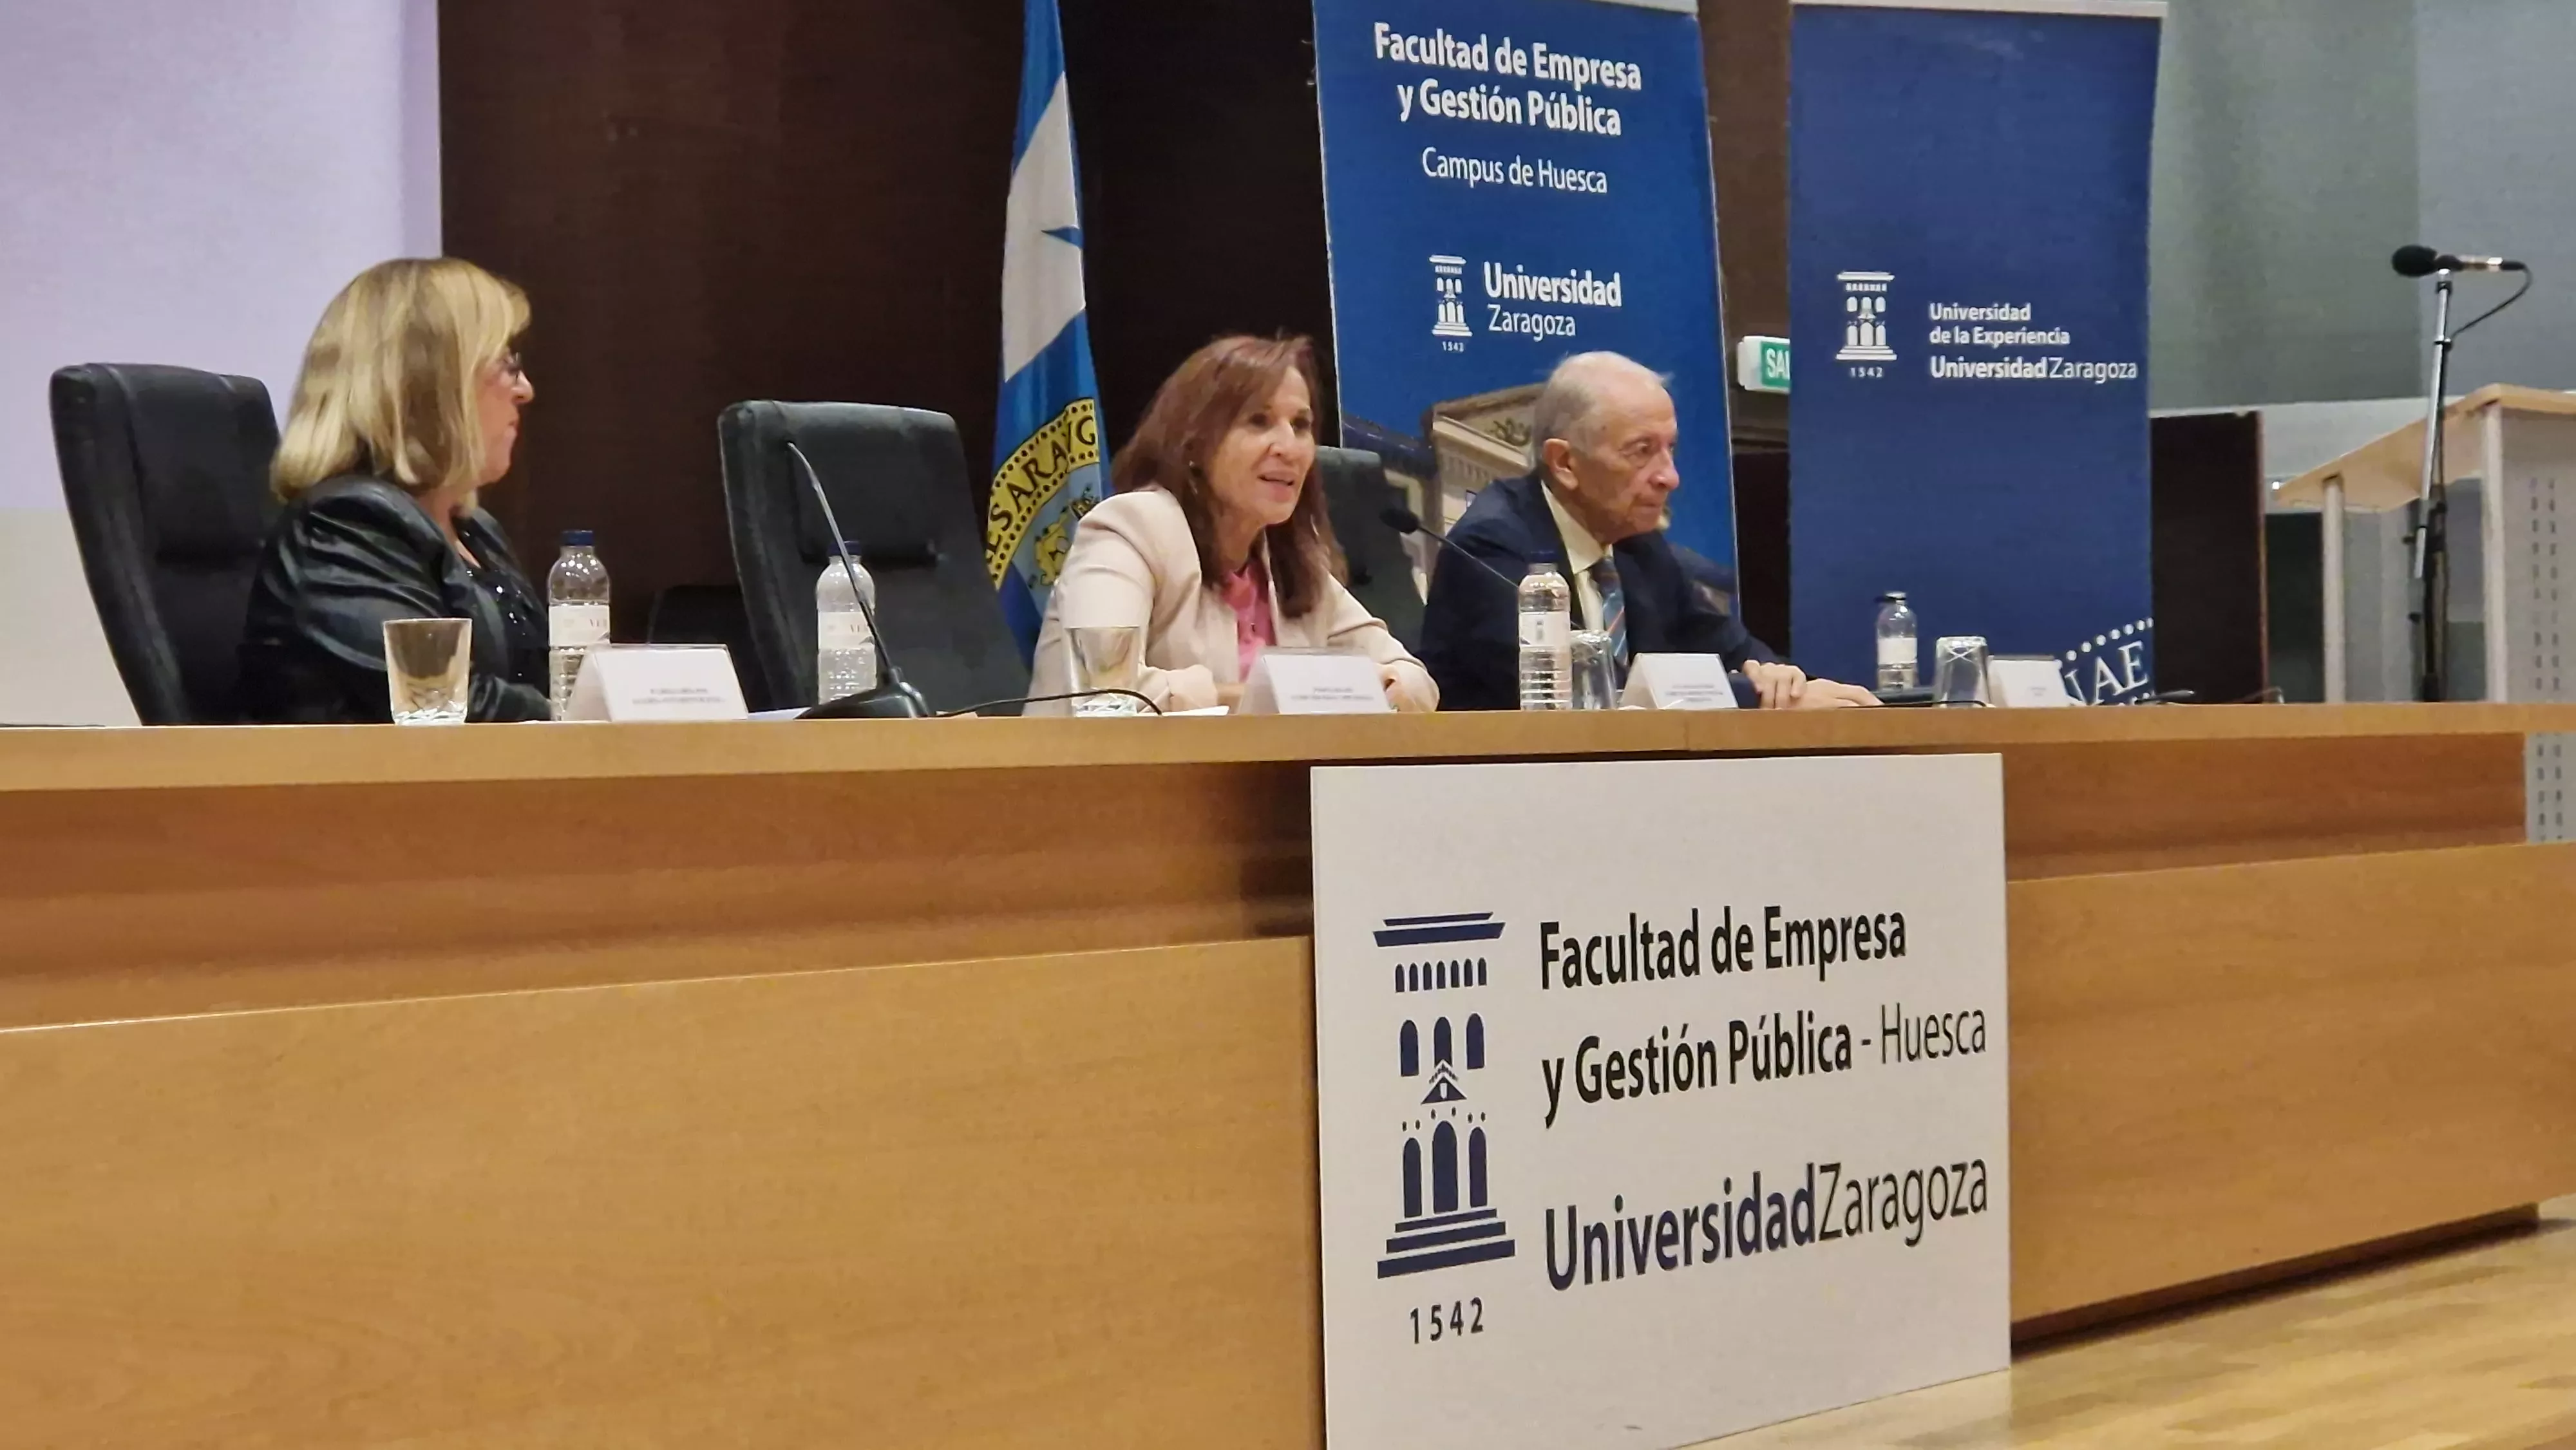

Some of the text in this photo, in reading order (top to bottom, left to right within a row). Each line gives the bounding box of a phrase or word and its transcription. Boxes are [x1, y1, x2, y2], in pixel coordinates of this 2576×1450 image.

[1374, 22, 1642, 92] Facultad de Empresa
[1397, 78, 1622, 136] y Gestión Pública
[1422, 147, 1607, 194] Campus de Huesca
[1483, 261, 1622, 307] Universidad
[1487, 303, 1576, 342] Zaragoza
[1929, 302, 2032, 322] Universidad
[1929, 325, 2071, 348] de la Experiencia
[1850, 366, 1884, 379] 1542
[1540, 905, 1906, 990] Facultad de Empresa
[1542, 1057, 1566, 1130] y
[1575, 1023, 1718, 1104] Gestión
[1728, 1010, 1853, 1085] Pública
[1881, 1003, 1986, 1064] Huesca
[1410, 1296, 1484, 1345] 1542
